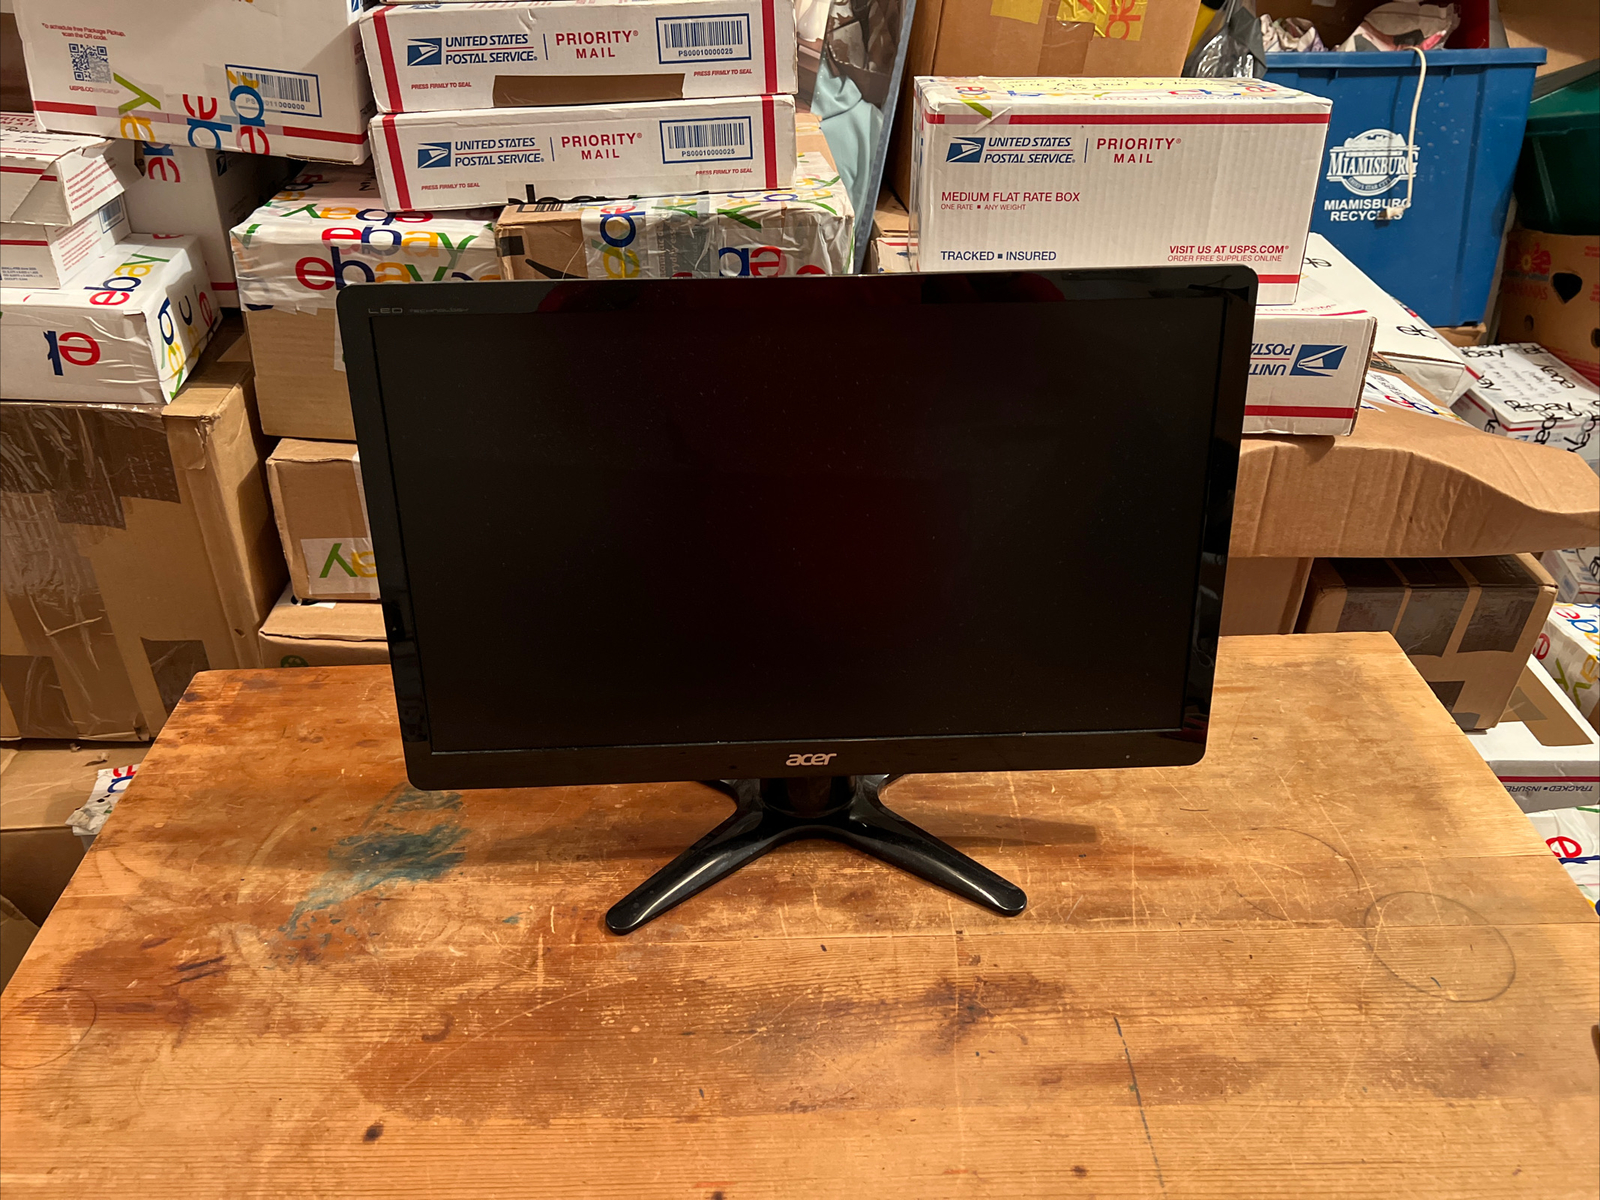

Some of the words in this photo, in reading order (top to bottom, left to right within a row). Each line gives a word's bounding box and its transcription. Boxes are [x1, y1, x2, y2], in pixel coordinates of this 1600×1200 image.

[446, 35, 487, 47] UNITED
[490, 34, 528, 45] STATES
[576, 47, 616, 59] MAIL
[678, 48, 734, 57] PS00010000025
[446, 53, 487, 64] POSTAL
[455, 139, 496, 150] UNITED
[498, 137, 535, 148] STATES
[988, 137, 1030, 147] UNITED
[1032, 137, 1071, 147] STATES
[581, 149, 620, 160] MAIL
[682, 148, 735, 157] PS00010000025
[984, 153, 1025, 163] POSTAL
[455, 156, 495, 167] POSTAL
[1113, 154, 1154, 163] MAIL
[941, 192, 990, 202] MEDIUM
[993, 192, 1020, 202] FLAT
[1023, 192, 1053, 202] RATE
[1055, 192, 1081, 202] BOX
[1169, 245, 1194, 254] VISIT
[1196, 245, 1211, 254] US
[1212, 245, 1227, 254] AT
[941, 251, 995, 261] TRACKED
[1005, 251, 1057, 261] INSURED
[1250, 343, 1296, 356] POST
[1248, 364, 1287, 376] UNIT
[785, 753, 837, 766] acer
